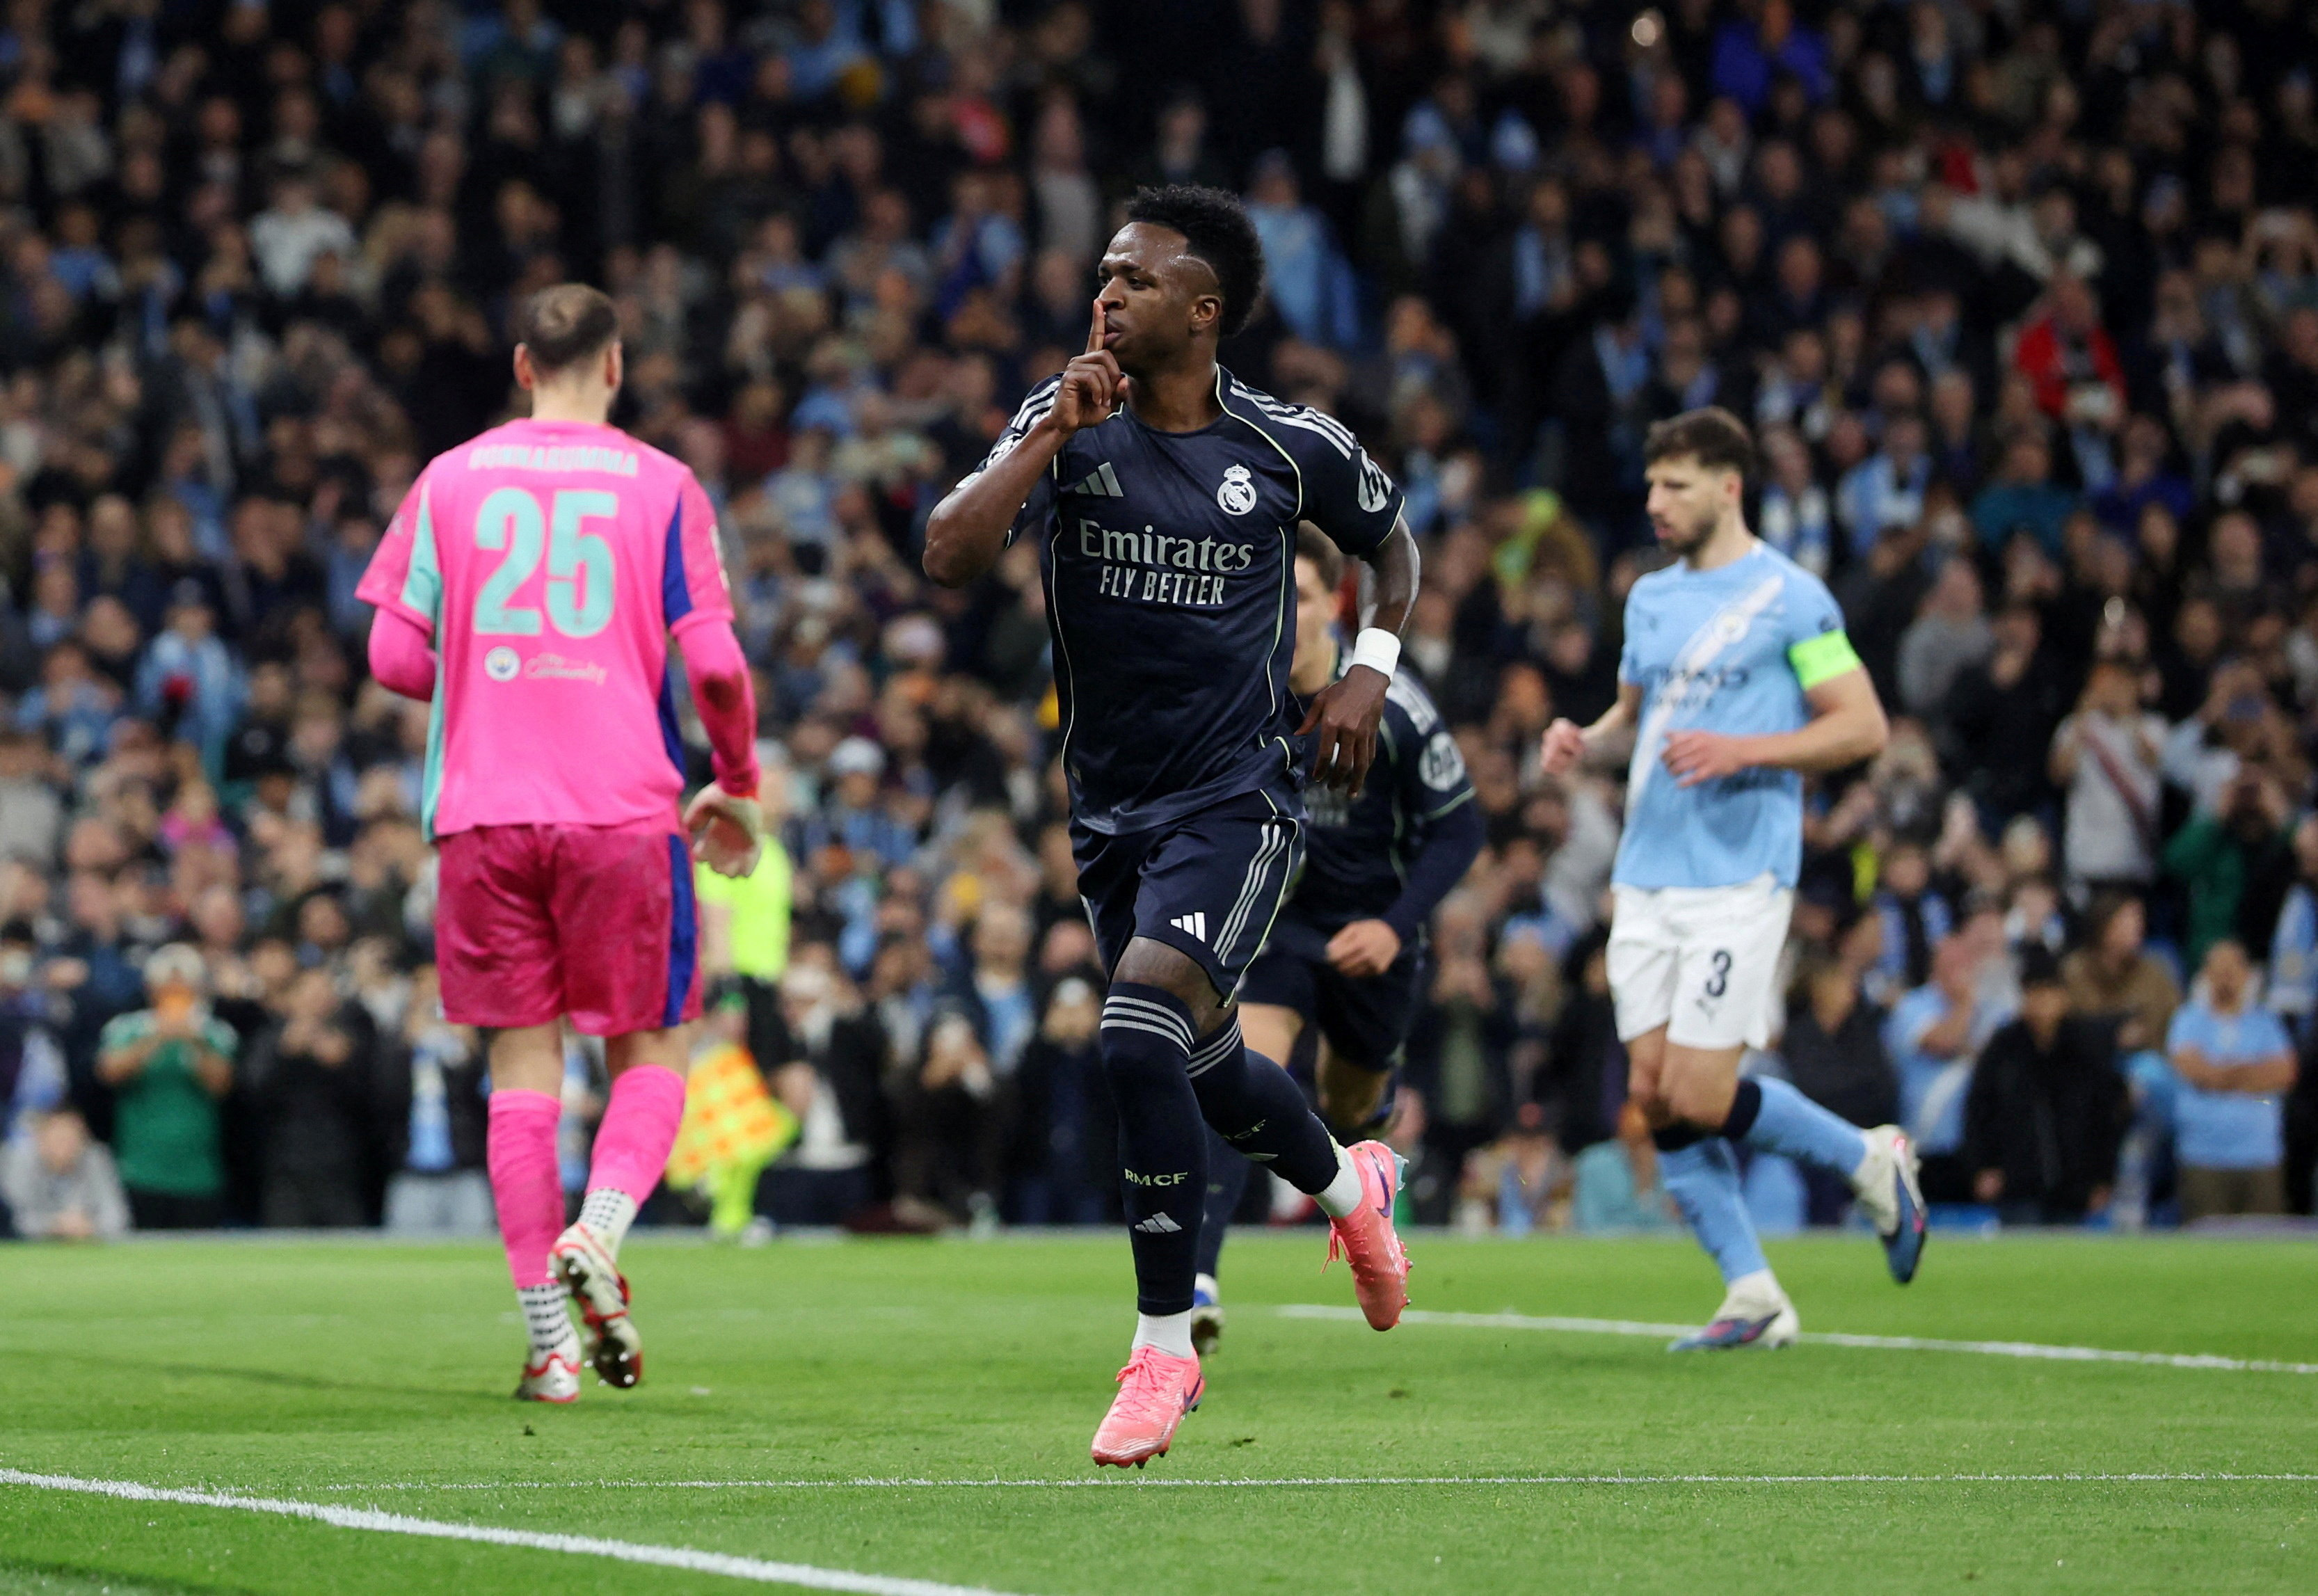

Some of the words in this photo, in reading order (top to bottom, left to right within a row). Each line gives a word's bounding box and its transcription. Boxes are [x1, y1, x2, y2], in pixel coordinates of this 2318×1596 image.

[473, 487, 618, 638] 25
[1080, 518, 1254, 571] Emirates
[1099, 565, 1137, 598] FLY
[1142, 570, 1225, 605] BETTER
[1706, 950, 1732, 997] 3
[1124, 1168, 1188, 1186] RMCF
